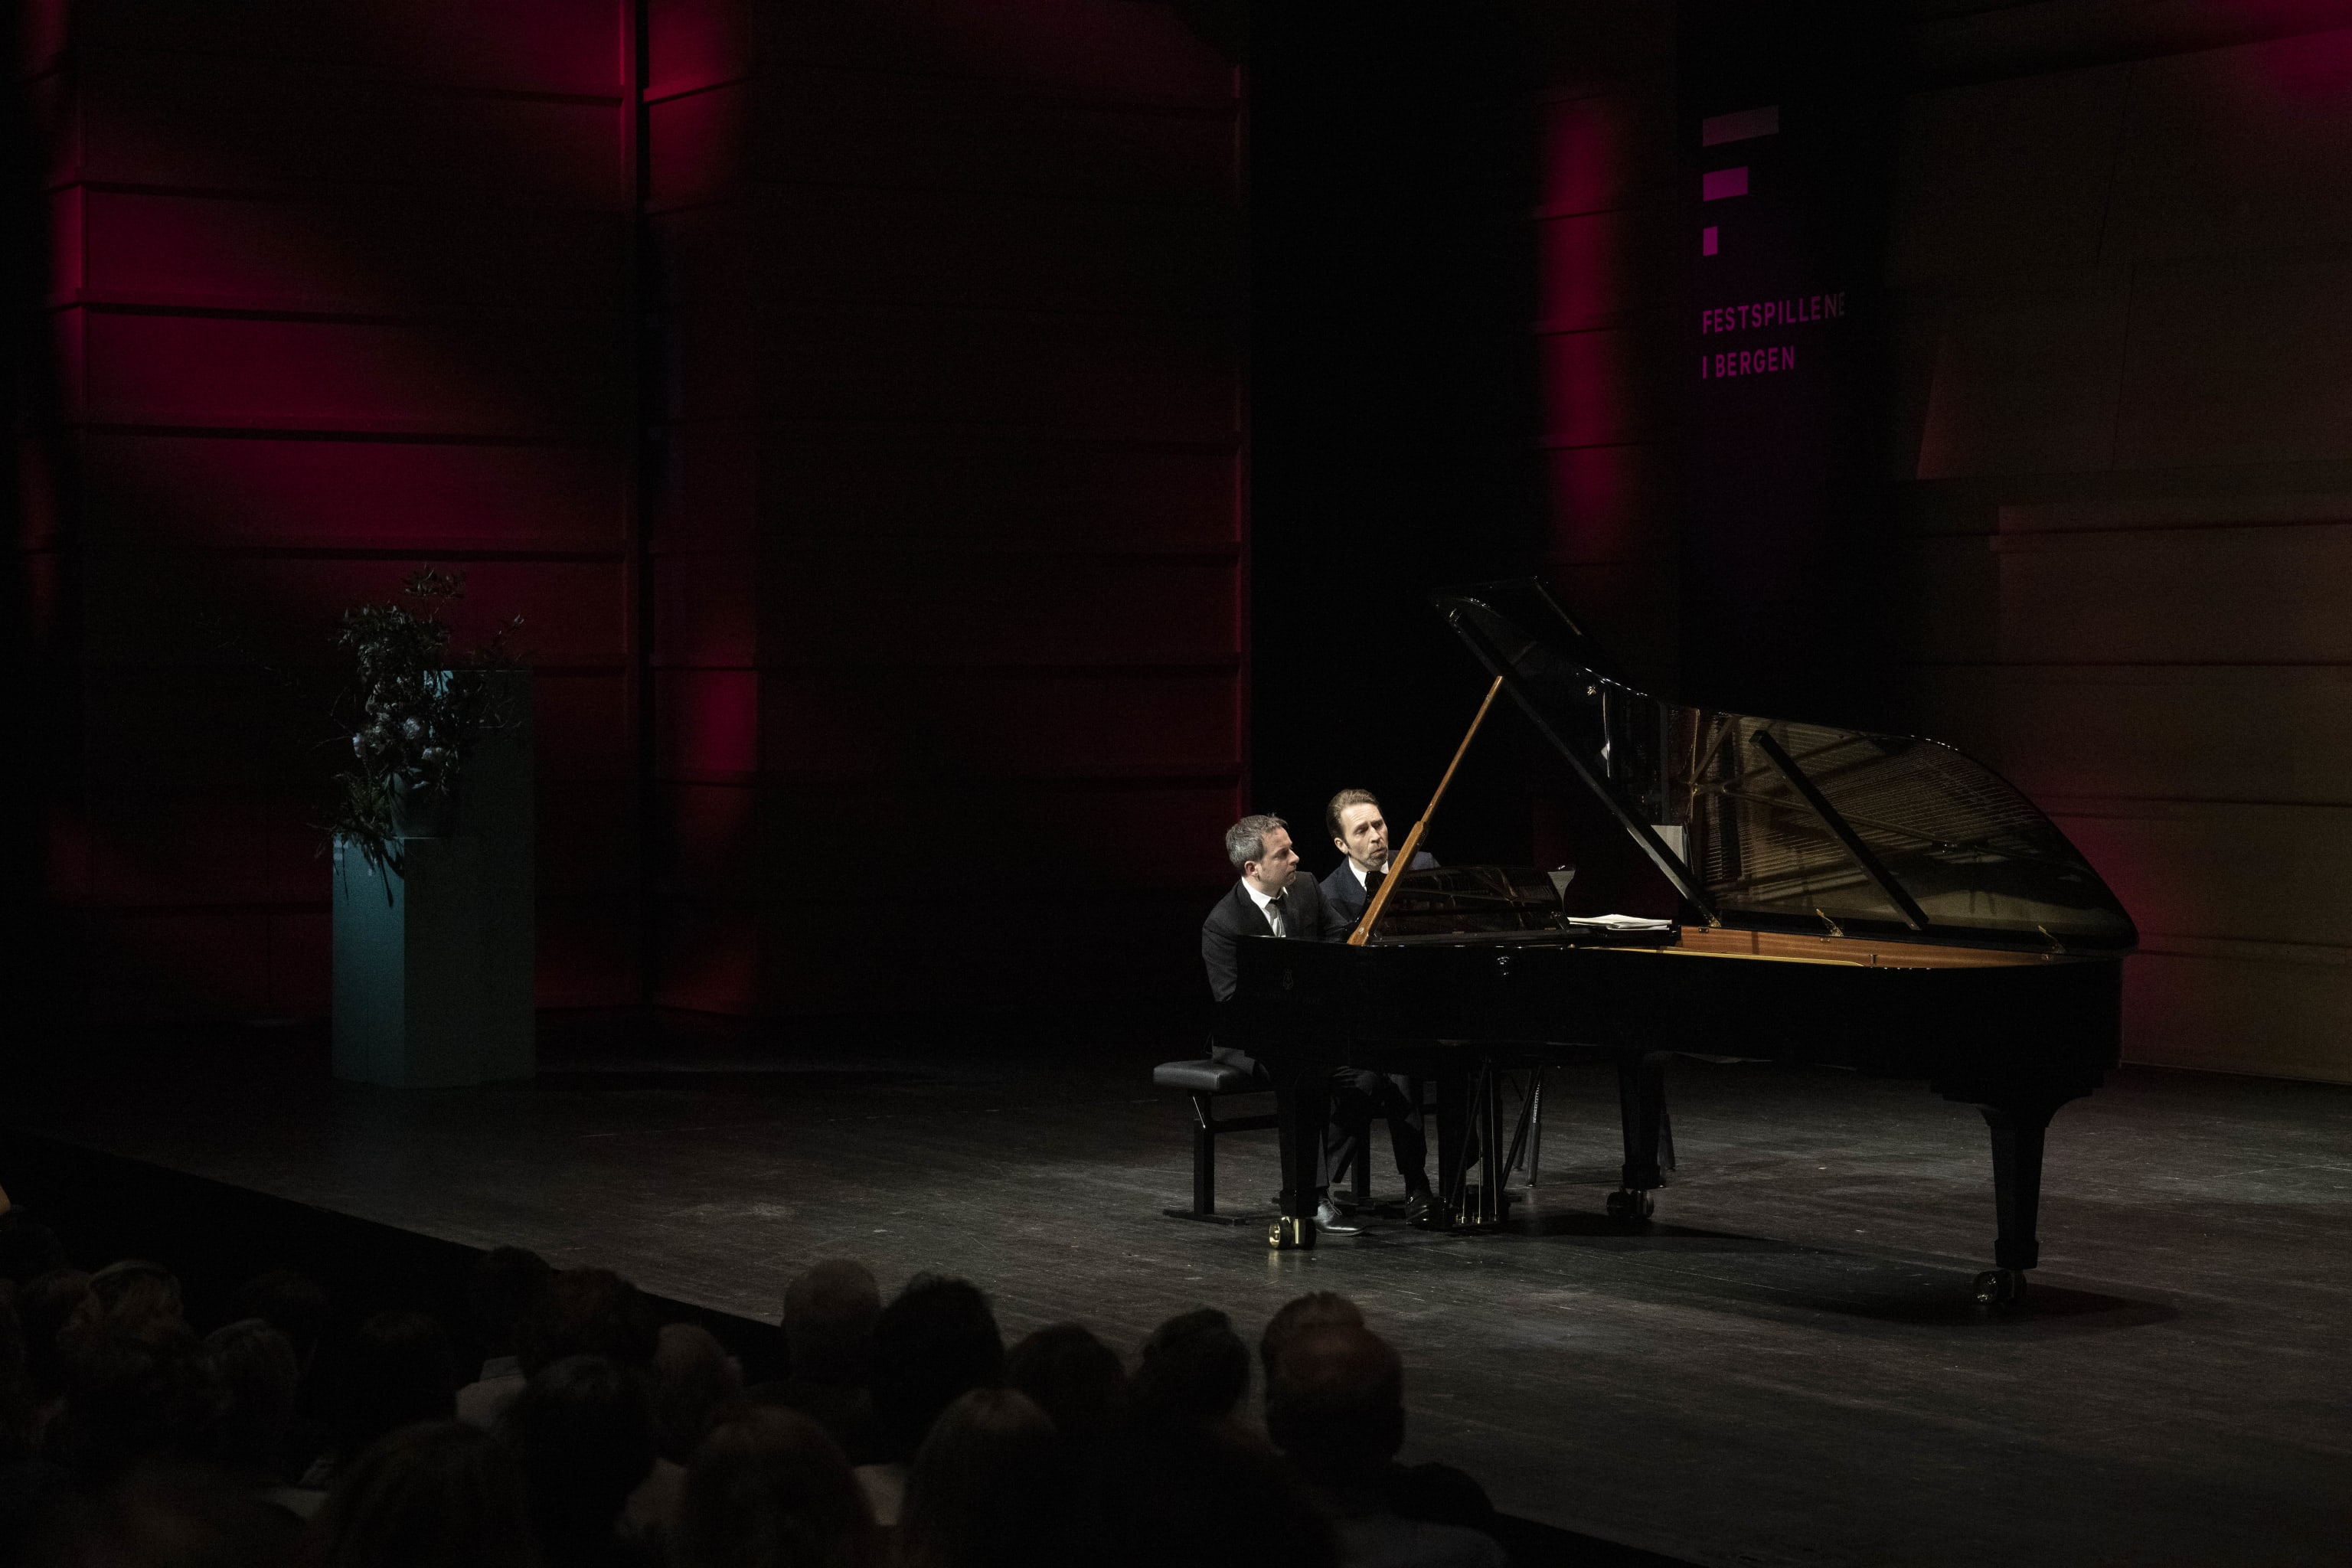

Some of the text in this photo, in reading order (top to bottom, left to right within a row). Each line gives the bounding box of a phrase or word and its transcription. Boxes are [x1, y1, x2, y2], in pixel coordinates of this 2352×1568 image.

[1703, 292, 1845, 335] FESTSPILLENE
[1702, 345, 1795, 379] I BERGEN
